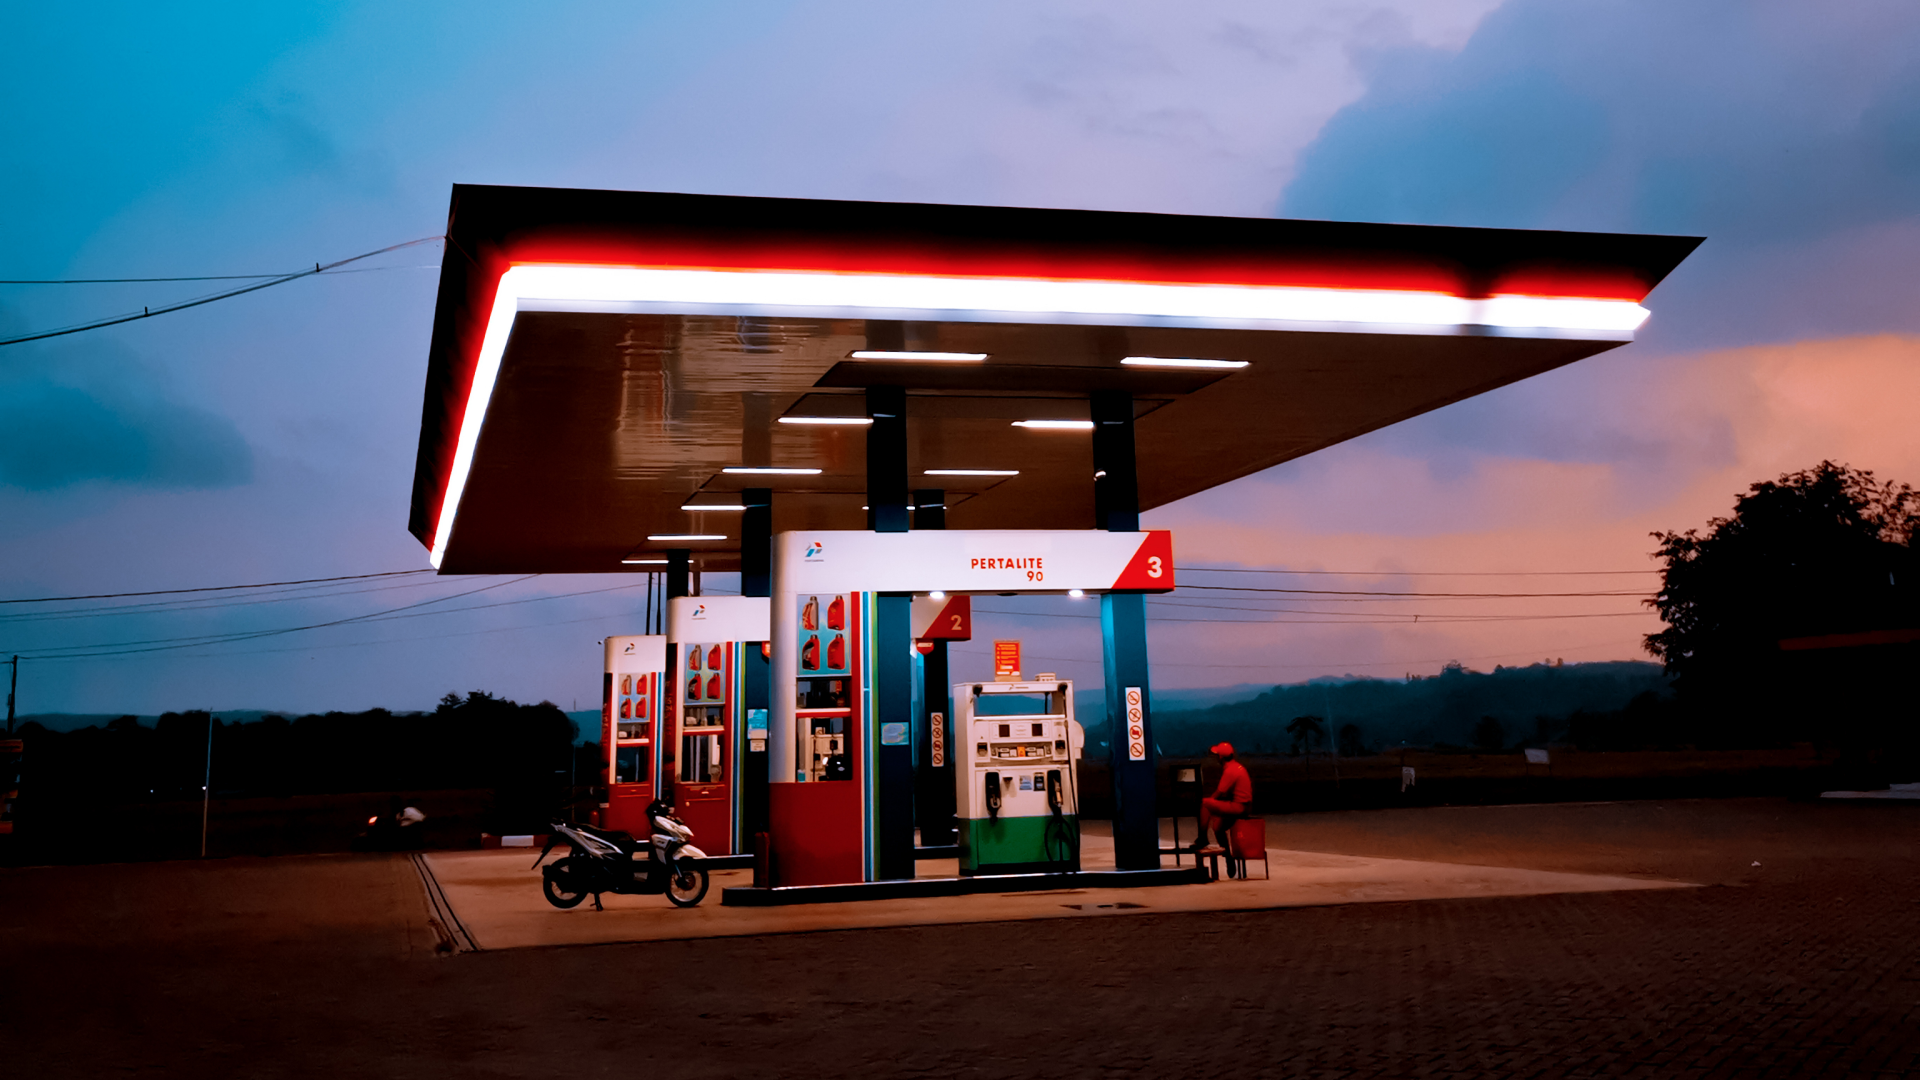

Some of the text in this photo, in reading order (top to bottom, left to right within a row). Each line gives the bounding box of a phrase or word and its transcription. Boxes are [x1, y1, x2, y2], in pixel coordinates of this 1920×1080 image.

[970, 557, 1043, 569] PERTALITE
[1147, 555, 1163, 579] 3
[1026, 570, 1044, 582] 90
[950, 614, 962, 631] 2
